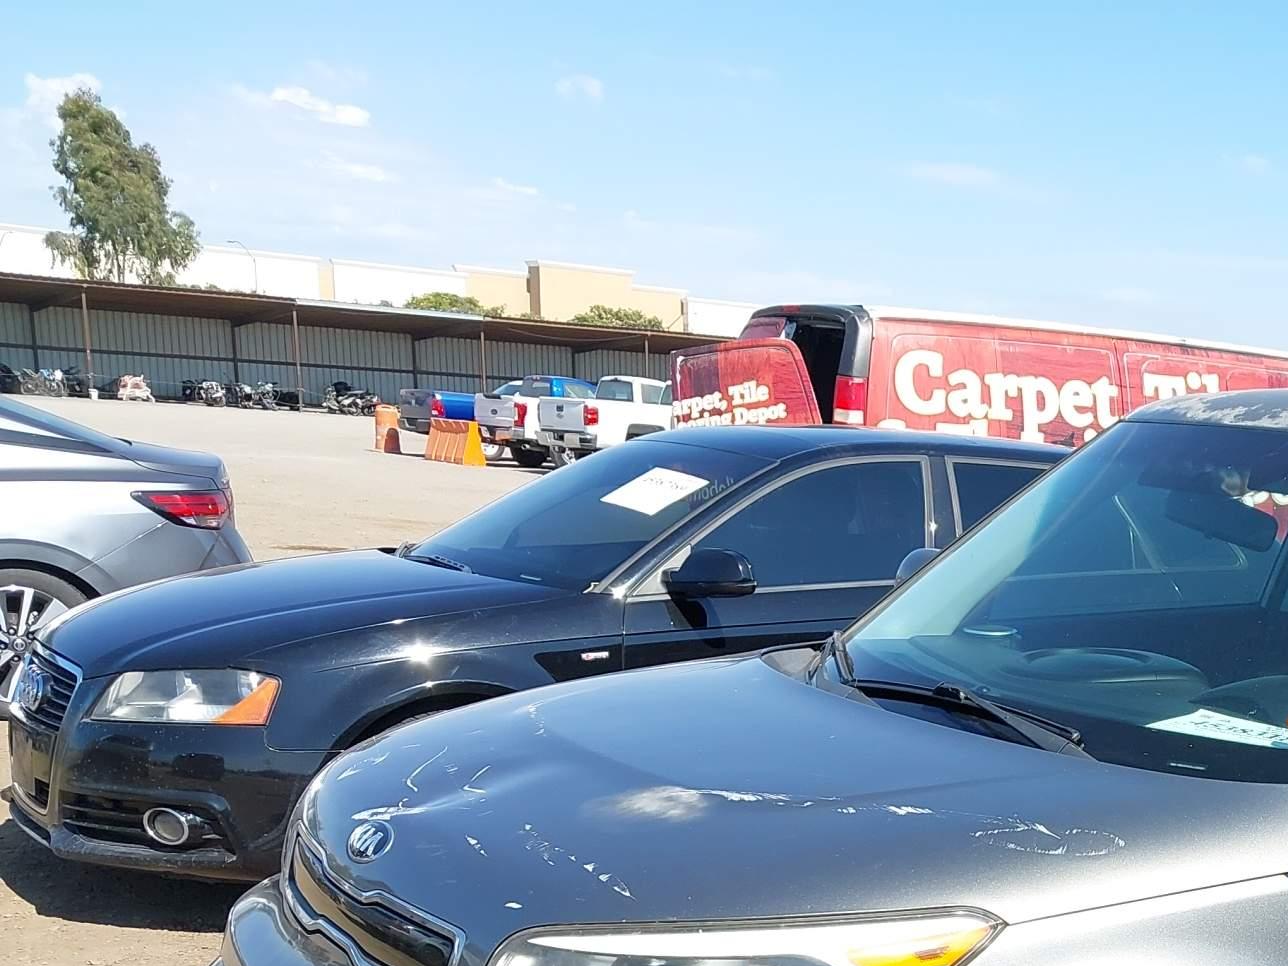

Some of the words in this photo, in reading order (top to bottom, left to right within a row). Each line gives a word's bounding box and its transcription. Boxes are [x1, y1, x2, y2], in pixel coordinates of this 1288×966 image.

[728, 380, 769, 406] Tile
[893, 349, 1119, 443] Carpet
[732, 402, 788, 425] Depot
